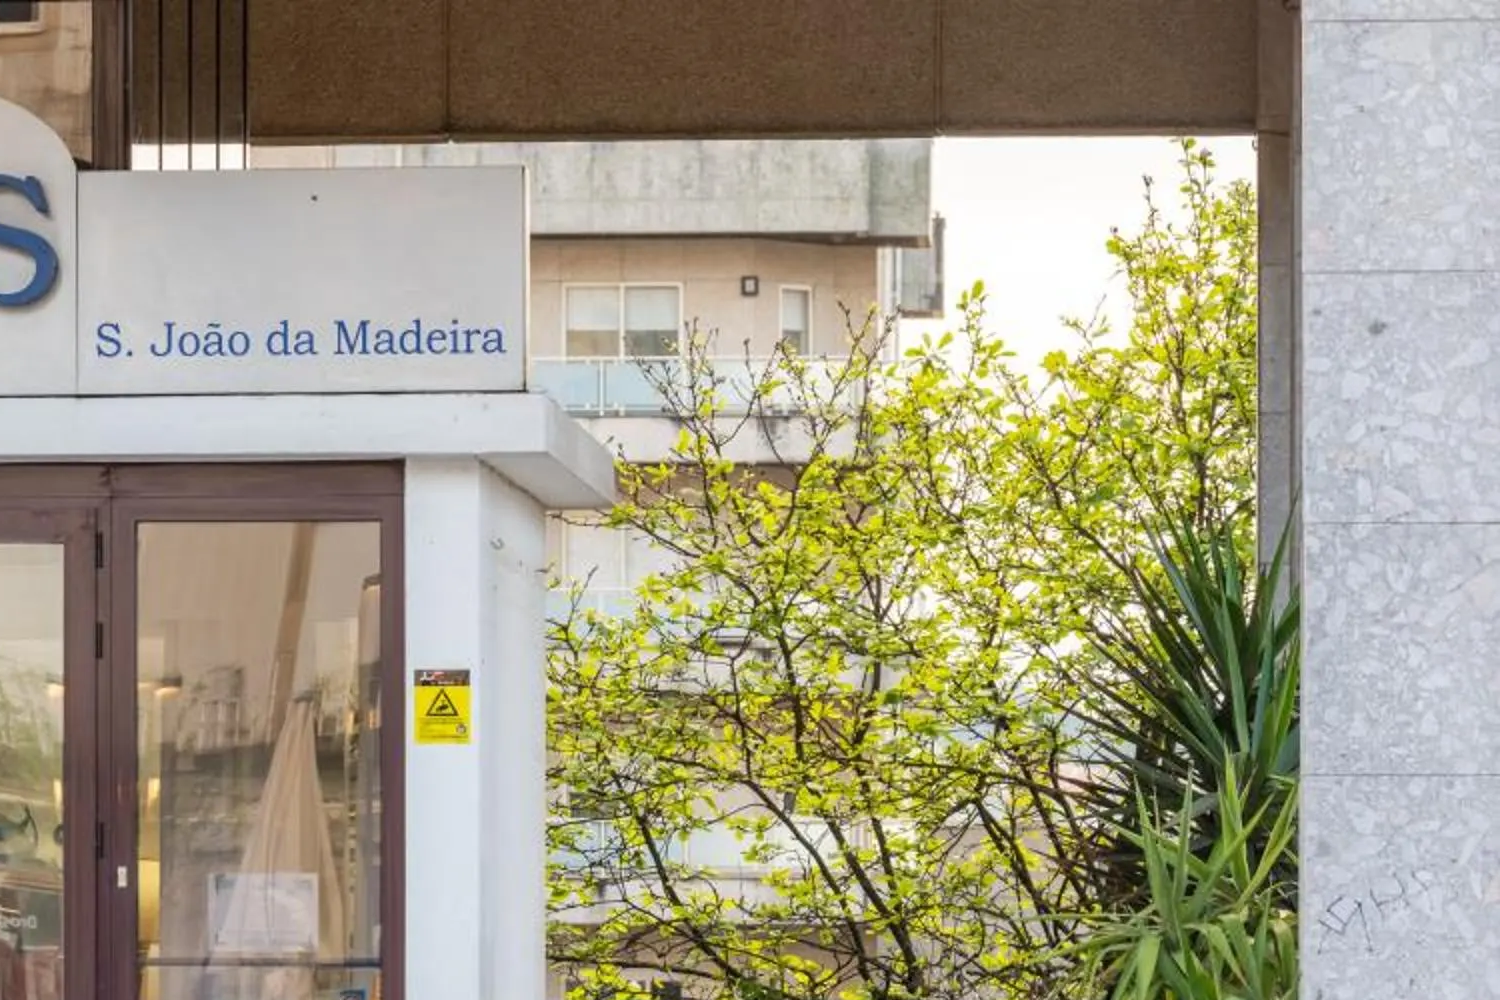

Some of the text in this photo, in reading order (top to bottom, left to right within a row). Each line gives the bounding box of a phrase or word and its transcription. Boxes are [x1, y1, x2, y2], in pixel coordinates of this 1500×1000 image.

[96, 319, 507, 359] S. João da Madeira
